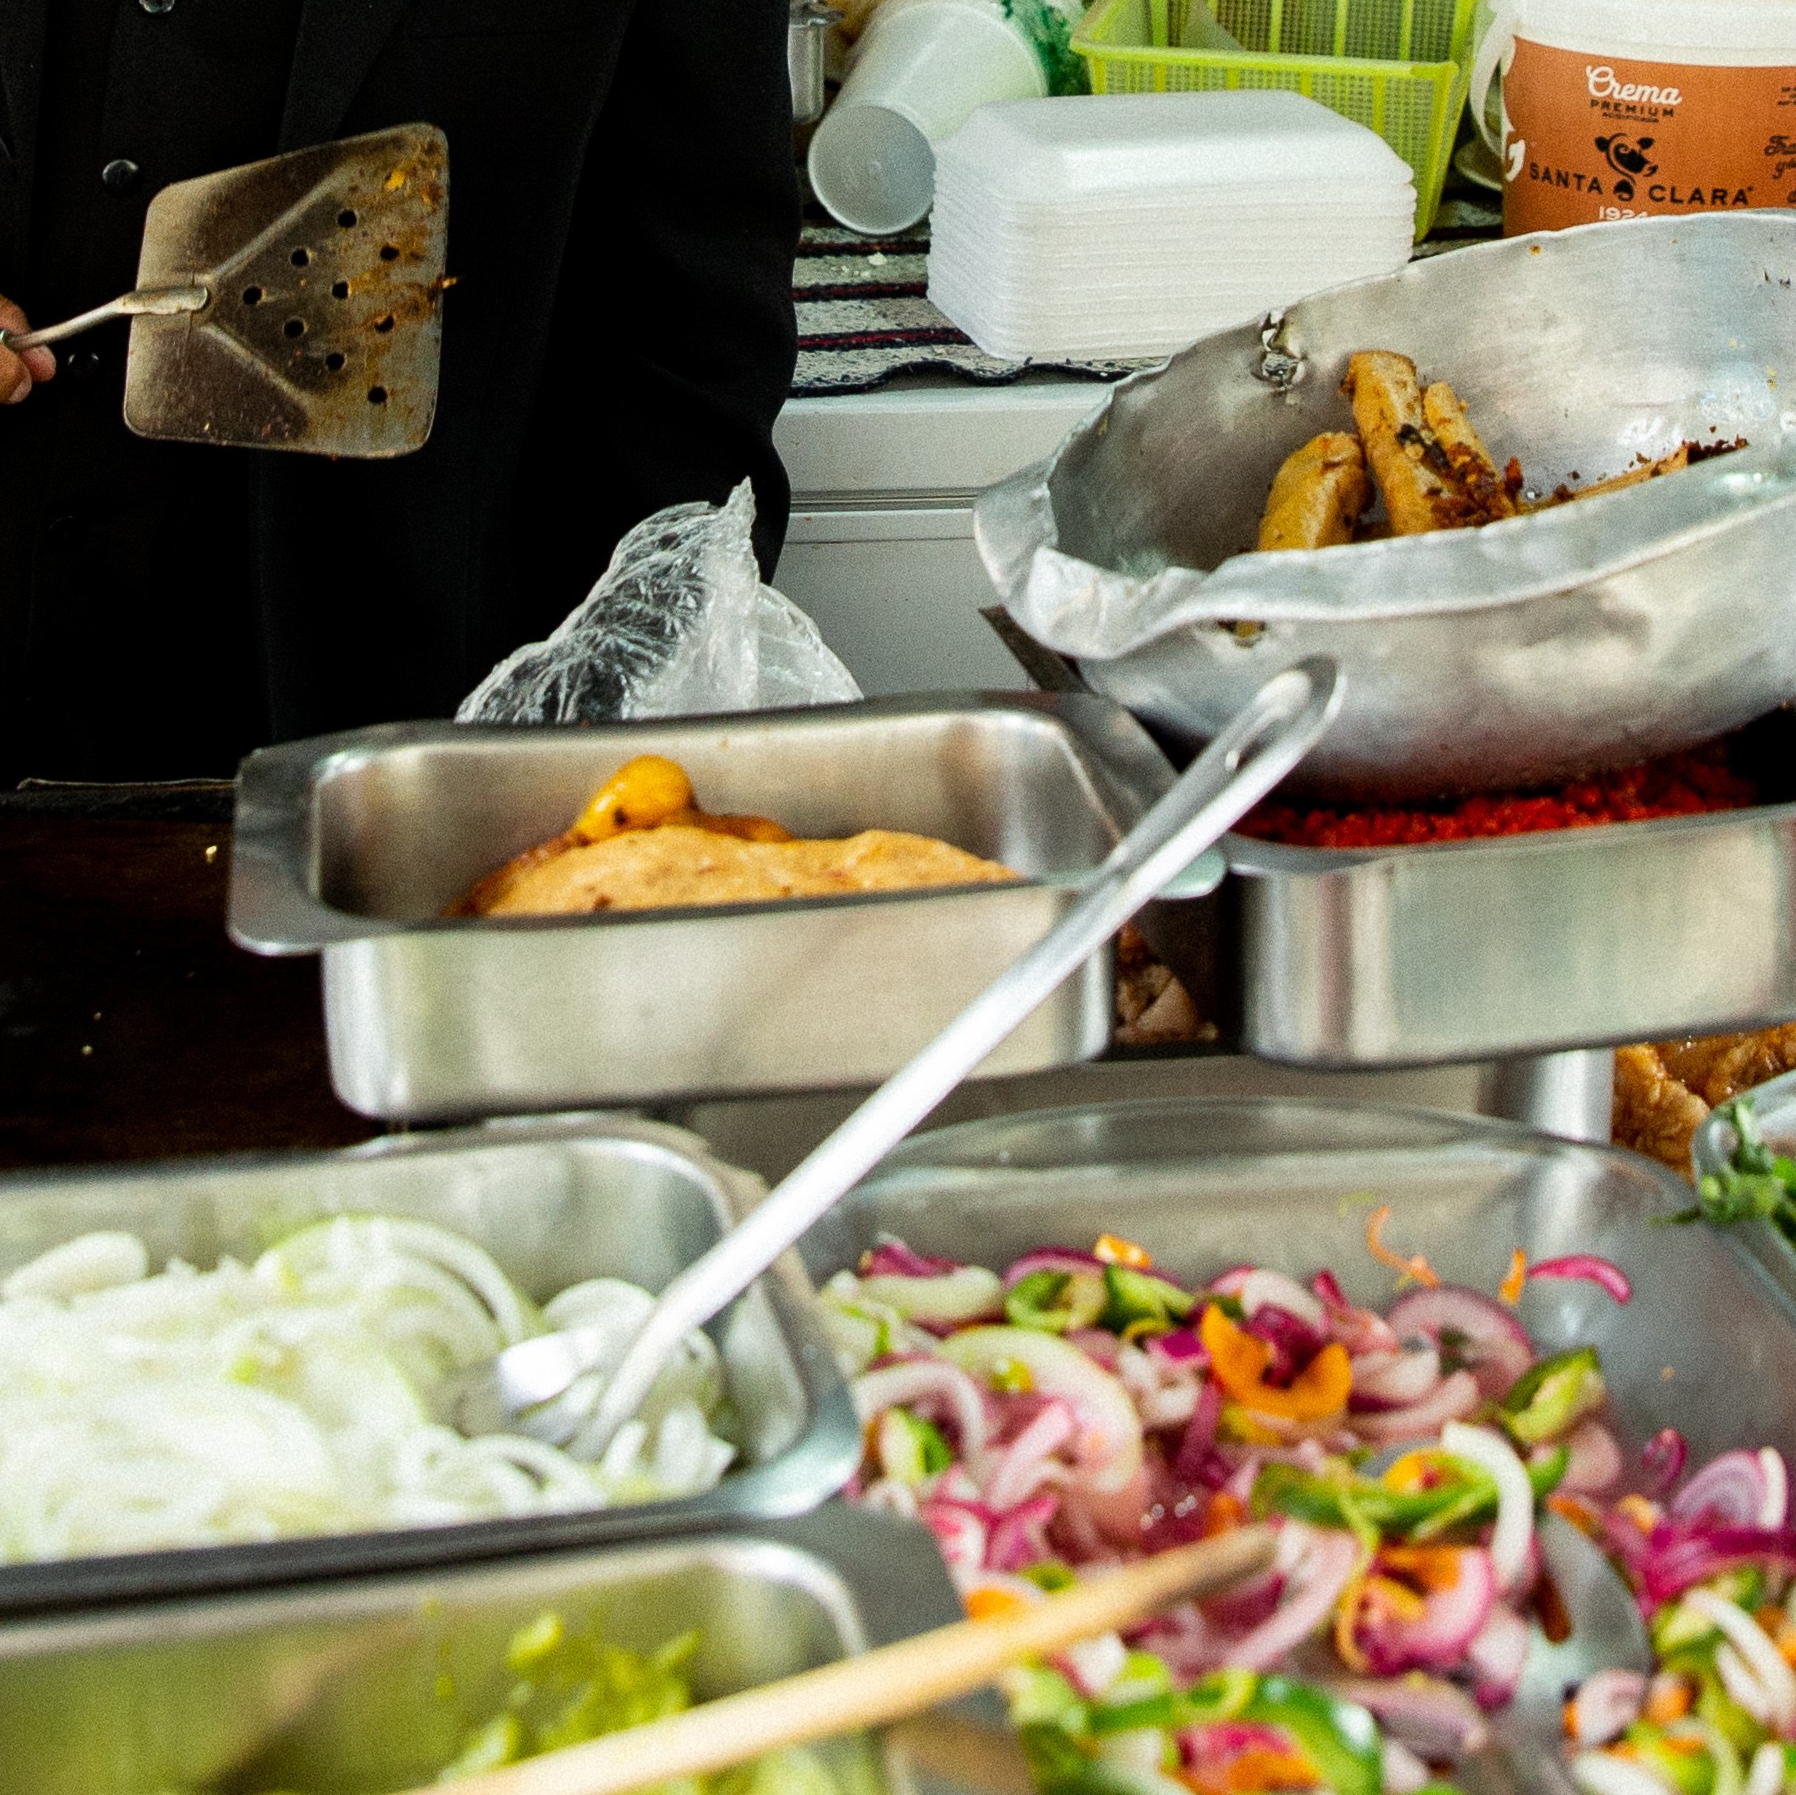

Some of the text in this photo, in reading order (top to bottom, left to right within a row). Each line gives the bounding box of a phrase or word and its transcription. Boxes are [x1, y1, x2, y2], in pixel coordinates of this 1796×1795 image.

[1585, 64, 1683, 106] Crema
[1589, 98, 1675, 118] PREMIUM
[1528, 163, 1751, 206] SANTA CLARA
